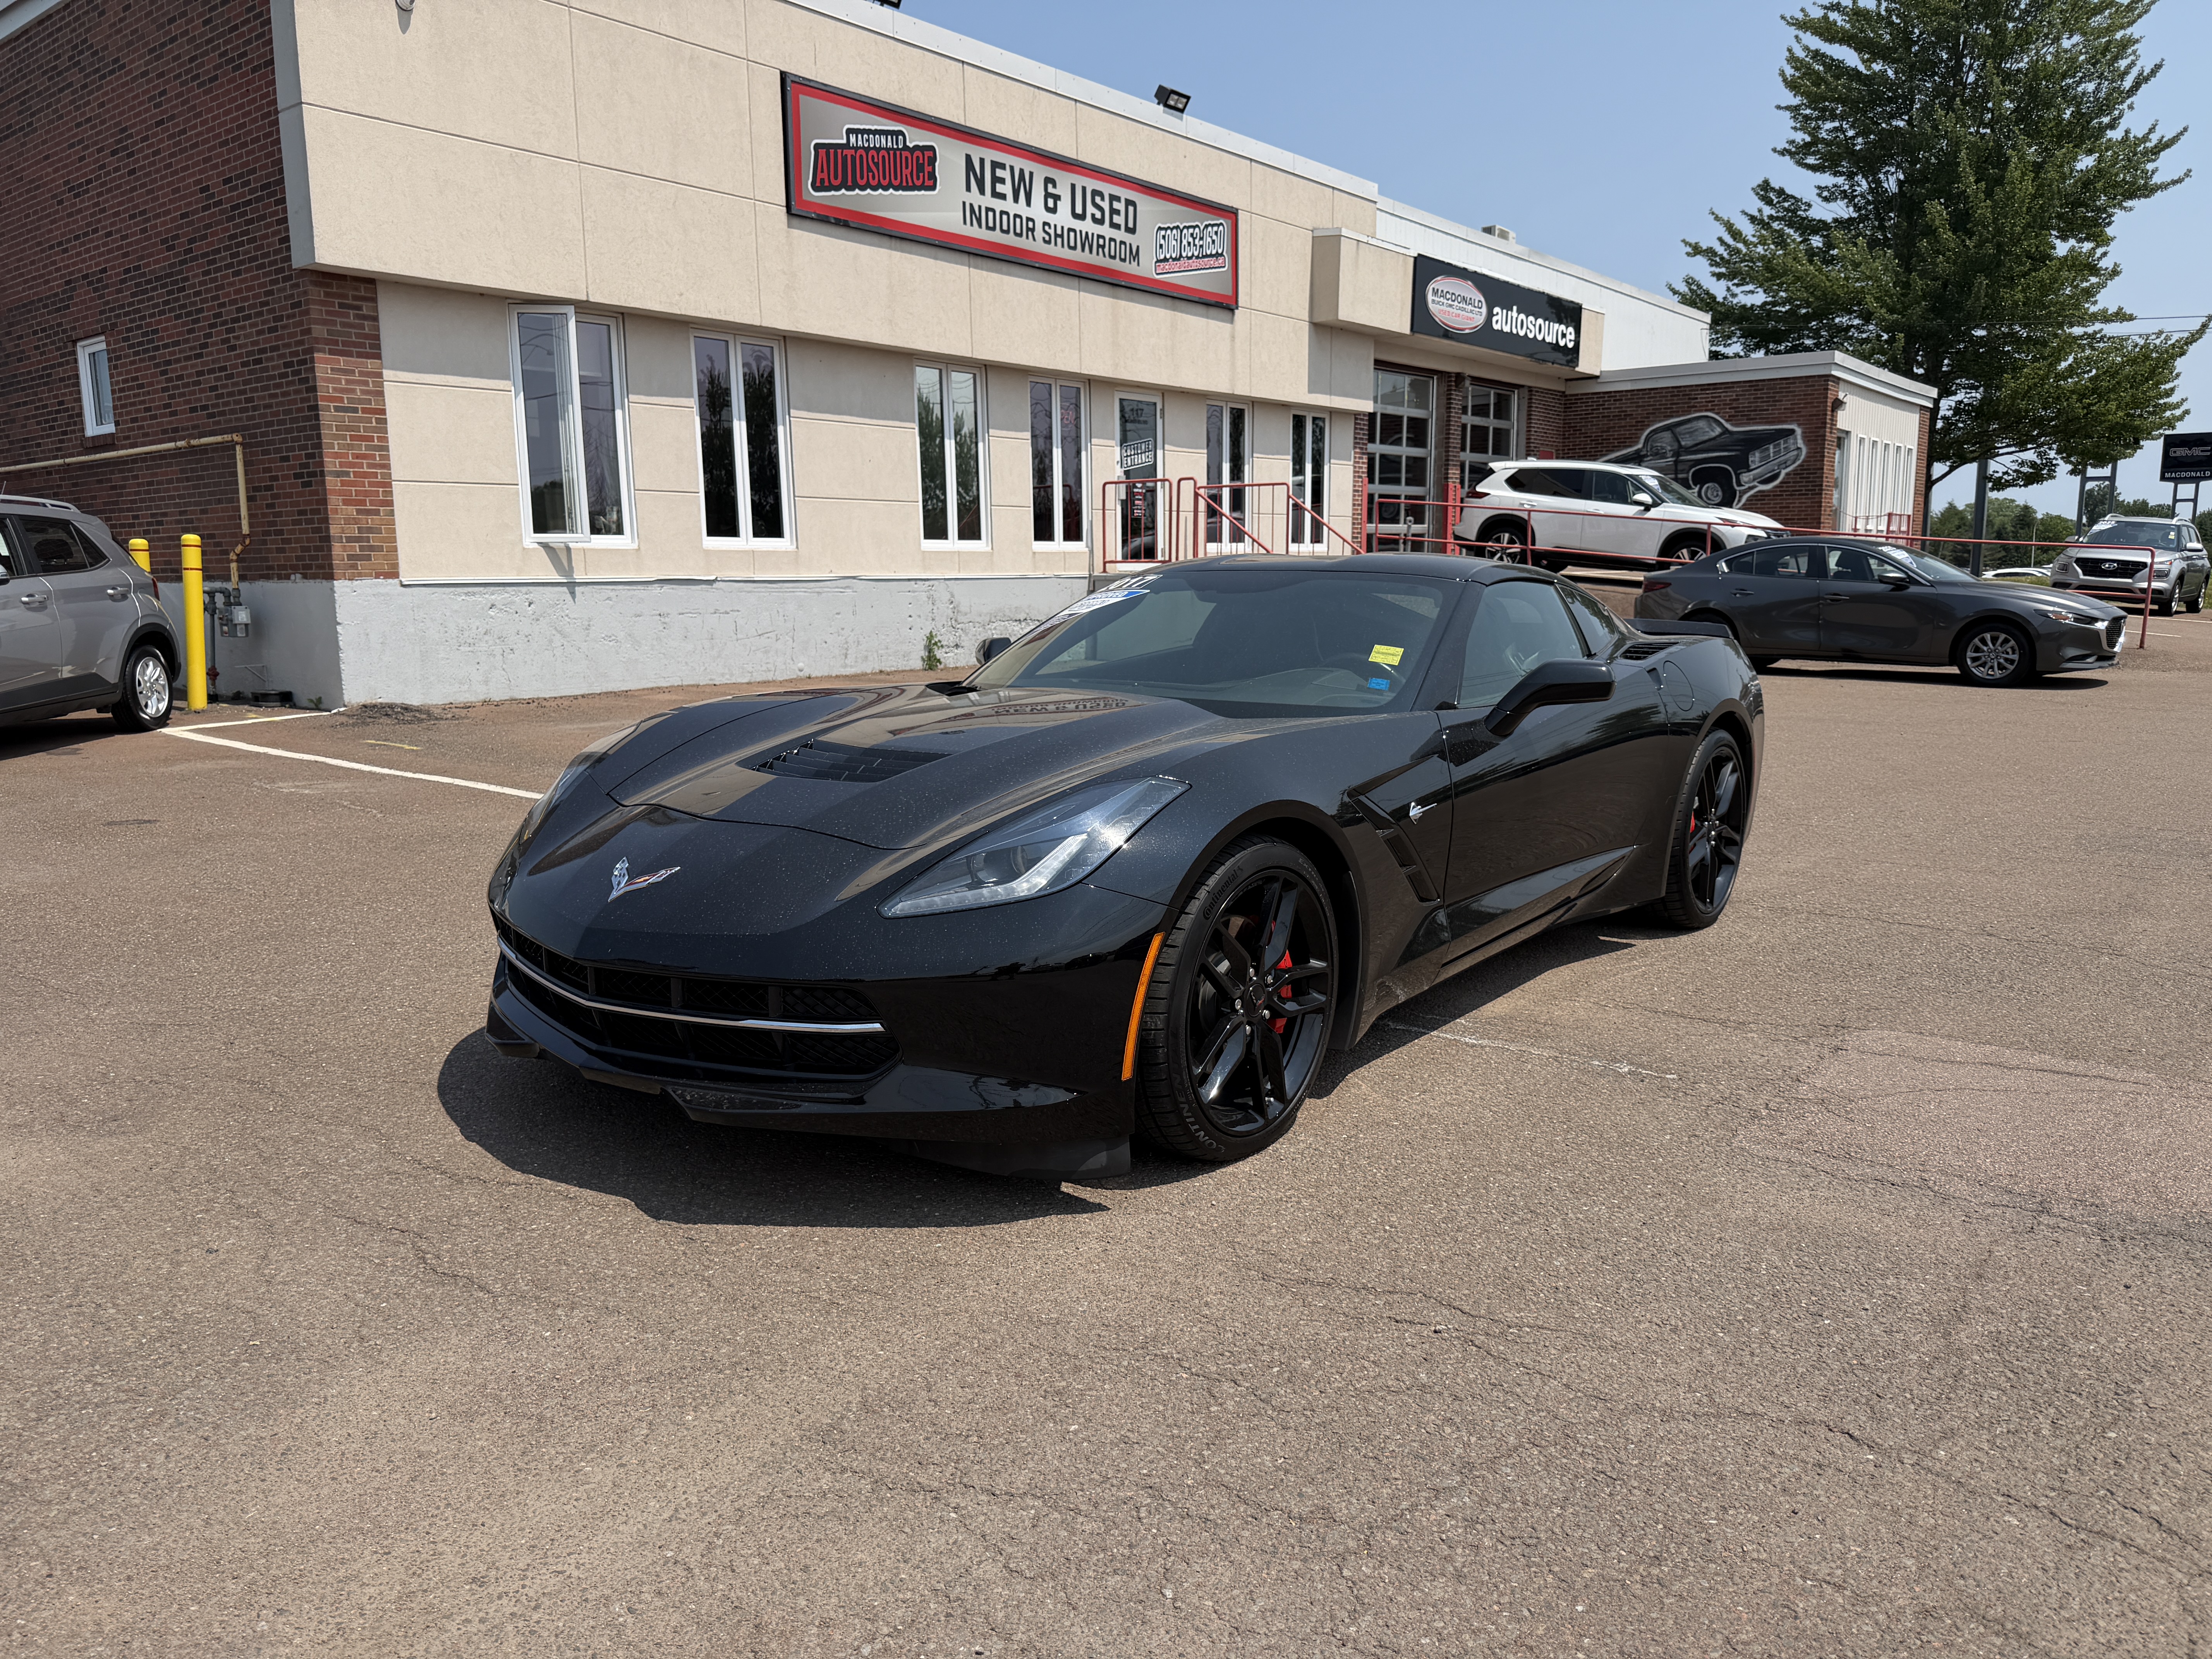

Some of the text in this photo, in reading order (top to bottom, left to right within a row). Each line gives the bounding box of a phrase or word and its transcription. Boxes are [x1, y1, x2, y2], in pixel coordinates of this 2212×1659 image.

[850, 134, 903, 148] MACDONALD
[816, 149, 934, 187] AUTOSOURCE
[965, 153, 1137, 235] NEW & USED
[962, 201, 1140, 267] INDOOR SHOWROOM
[1157, 225, 1224, 260] (506) 853-1650
[1432, 287, 1483, 309] MACDONALD
[1438, 308, 1451, 316] USED
[1492, 305, 1575, 348] autosource
[1061, 409, 1075, 425] PEN
[1124, 440, 1152, 456] CUSTOMER
[1124, 451, 1152, 467] ENTRANCE
[2169, 447, 2211, 457] GMC
[1203, 869, 1239, 921] Continental
